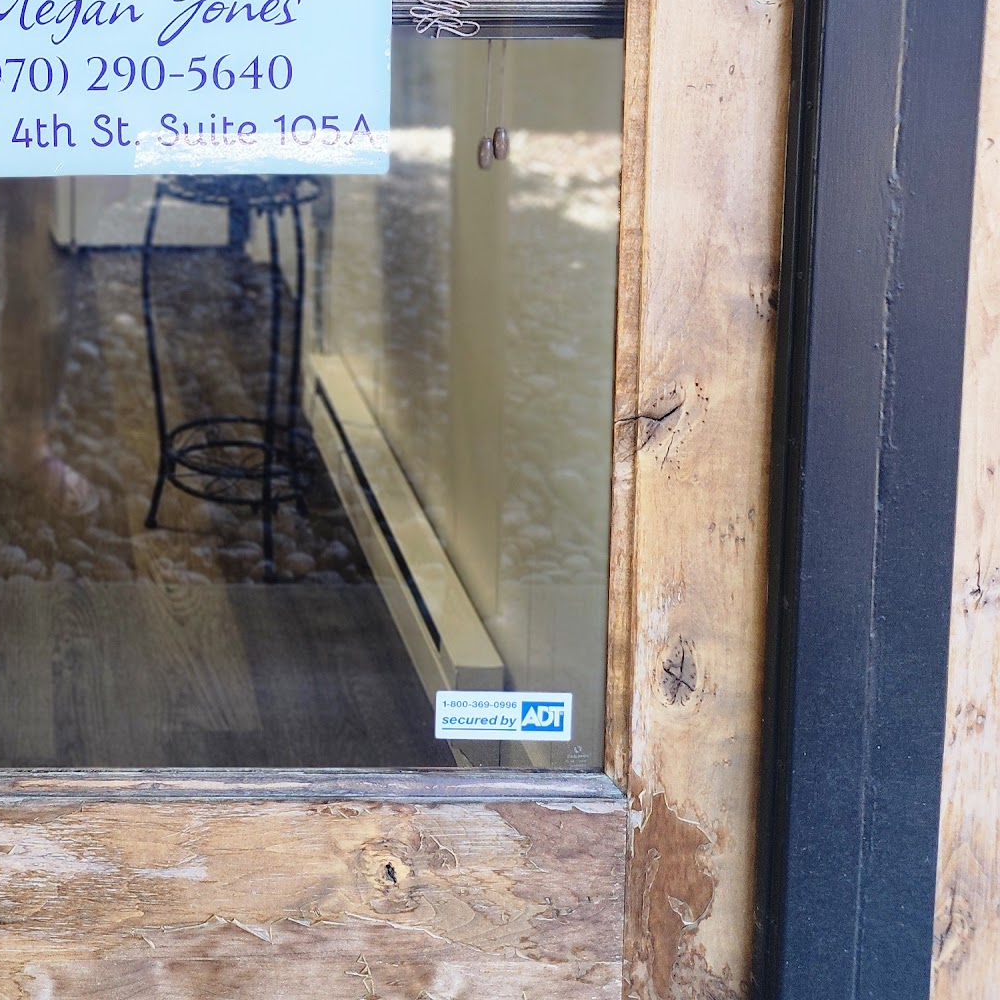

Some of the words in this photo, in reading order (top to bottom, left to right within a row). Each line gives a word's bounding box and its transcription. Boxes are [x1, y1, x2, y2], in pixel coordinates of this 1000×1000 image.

[86, 53, 293, 92] 290-5640
[11, 113, 77, 149] 4th
[90, 113, 141, 148] St.
[157, 112, 258, 147] Suite
[273, 112, 377, 147] 105A
[442, 700, 517, 709] 1-800-369-0996
[441, 715, 498, 725] secured
[500, 716, 517, 728] by
[521, 705, 565, 728] ADT
